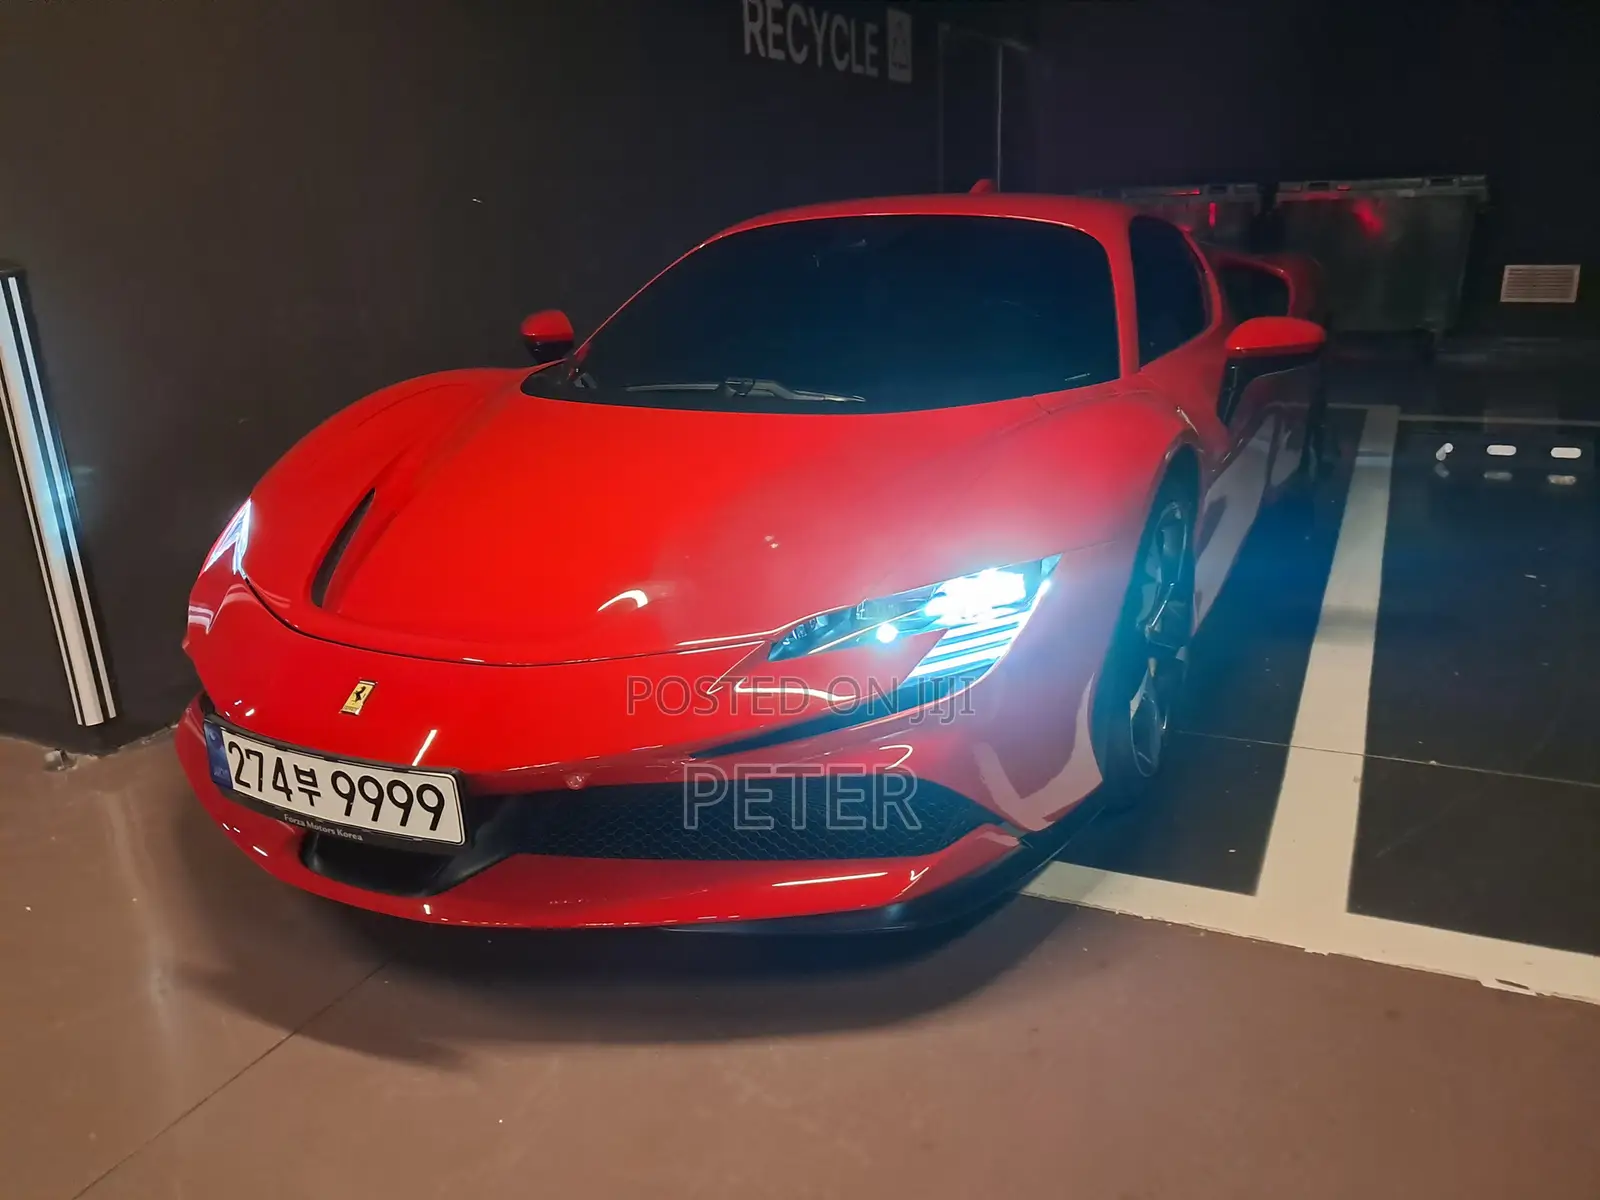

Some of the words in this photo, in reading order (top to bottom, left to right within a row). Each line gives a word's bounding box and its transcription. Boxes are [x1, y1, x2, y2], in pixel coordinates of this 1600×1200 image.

[742, 0, 879, 78] RECYCLE
[228, 741, 322, 807] 274부
[330, 770, 445, 832] 9999
[283, 813, 306, 827] Forza
[306, 820, 336, 835] Motors
[336, 828, 364, 841] Korea
